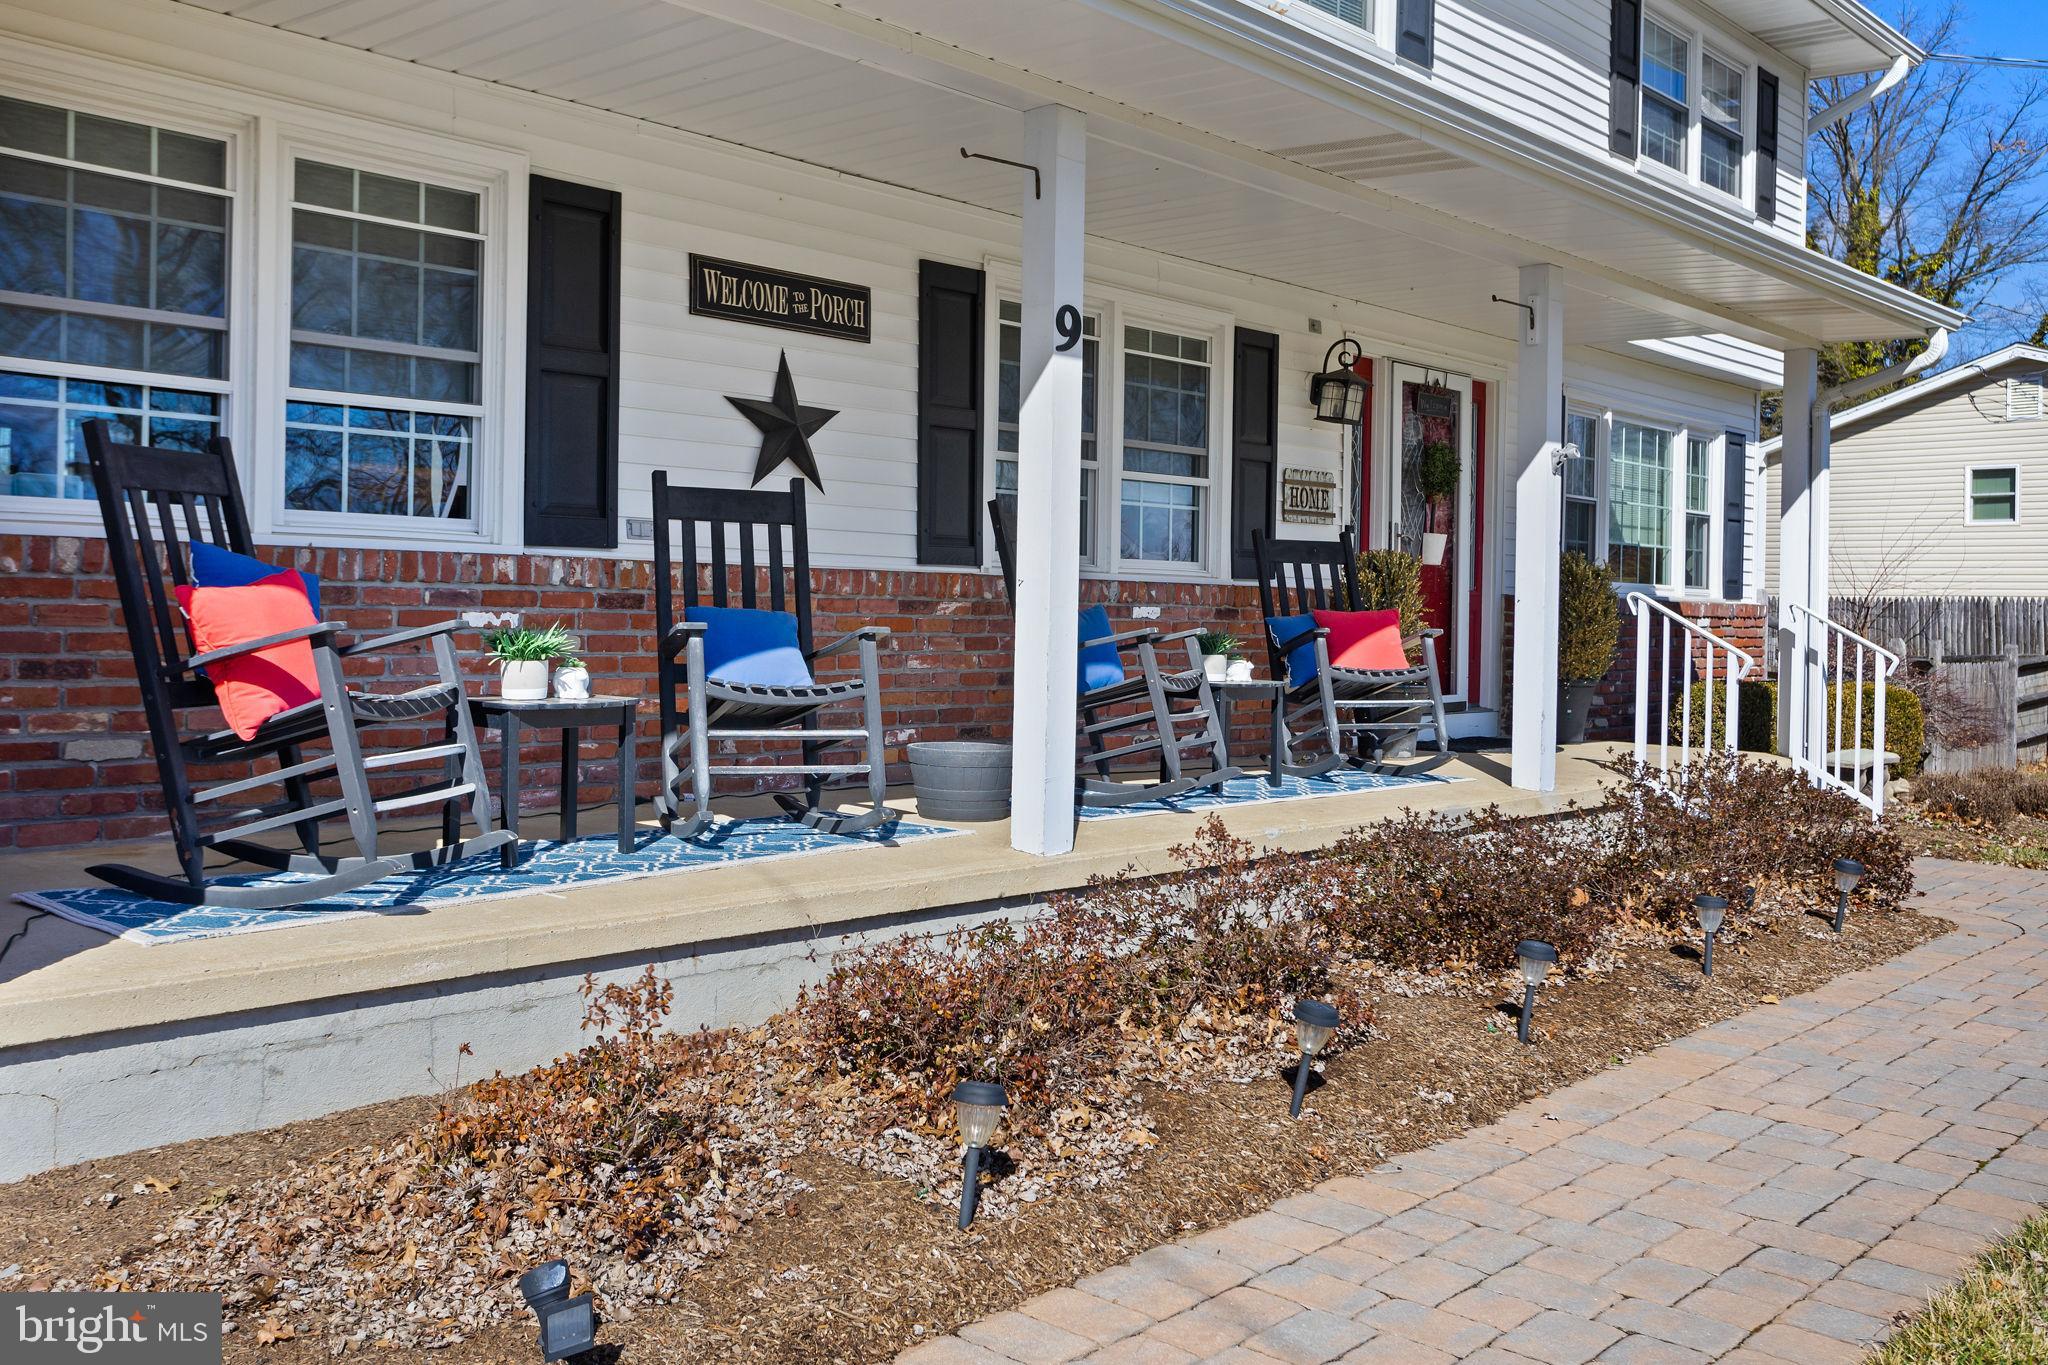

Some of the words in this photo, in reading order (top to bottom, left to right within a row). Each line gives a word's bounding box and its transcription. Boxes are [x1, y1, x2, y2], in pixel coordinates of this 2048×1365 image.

[703, 268, 789, 316] WELCOME
[792, 291, 805, 302] TO
[792, 302, 809, 314] THE
[809, 287, 866, 328] PORCH
[1055, 304, 1082, 352] 9
[1289, 486, 1330, 511] HOME
